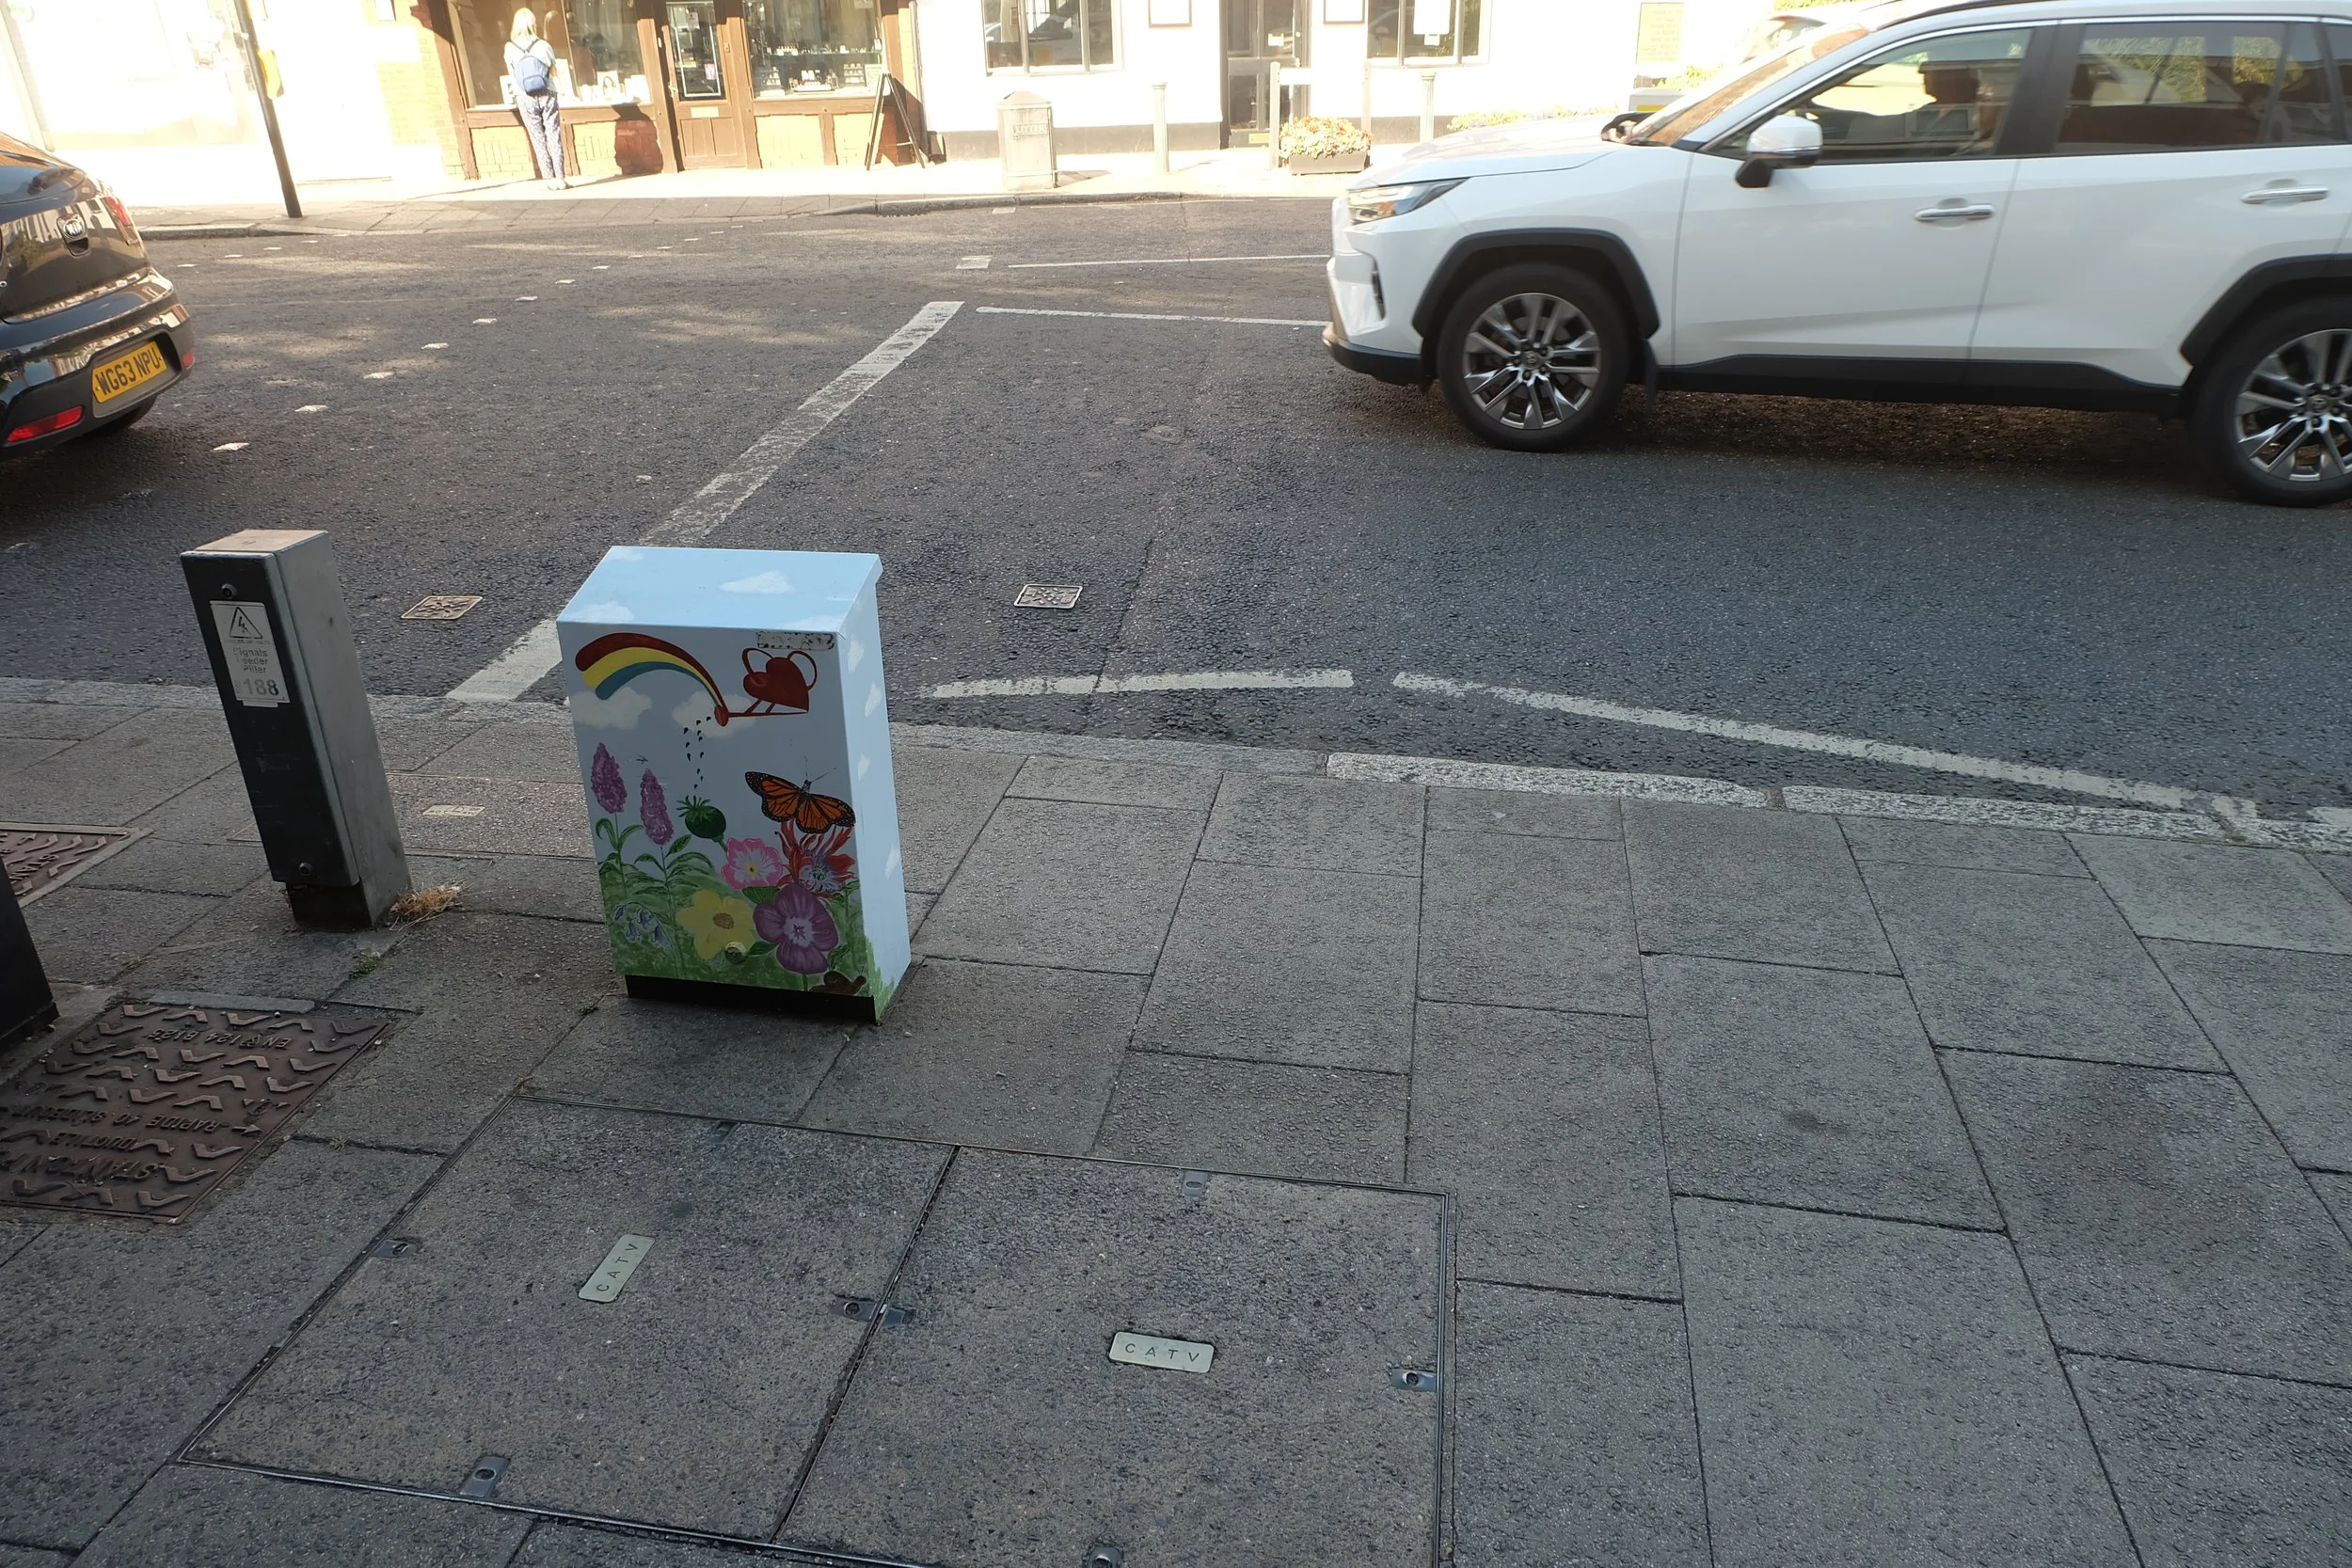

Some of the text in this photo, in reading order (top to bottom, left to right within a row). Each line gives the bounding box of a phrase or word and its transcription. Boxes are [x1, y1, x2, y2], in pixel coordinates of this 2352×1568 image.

[95, 347, 160, 395] WG63 NPU
[236, 657, 268, 666] eeder
[244, 678, 279, 696] 188
[146, 1115, 221, 1133] RAPIDE
[596, 1243, 638, 1292] CATV
[1124, 1342, 1200, 1363] CATV
